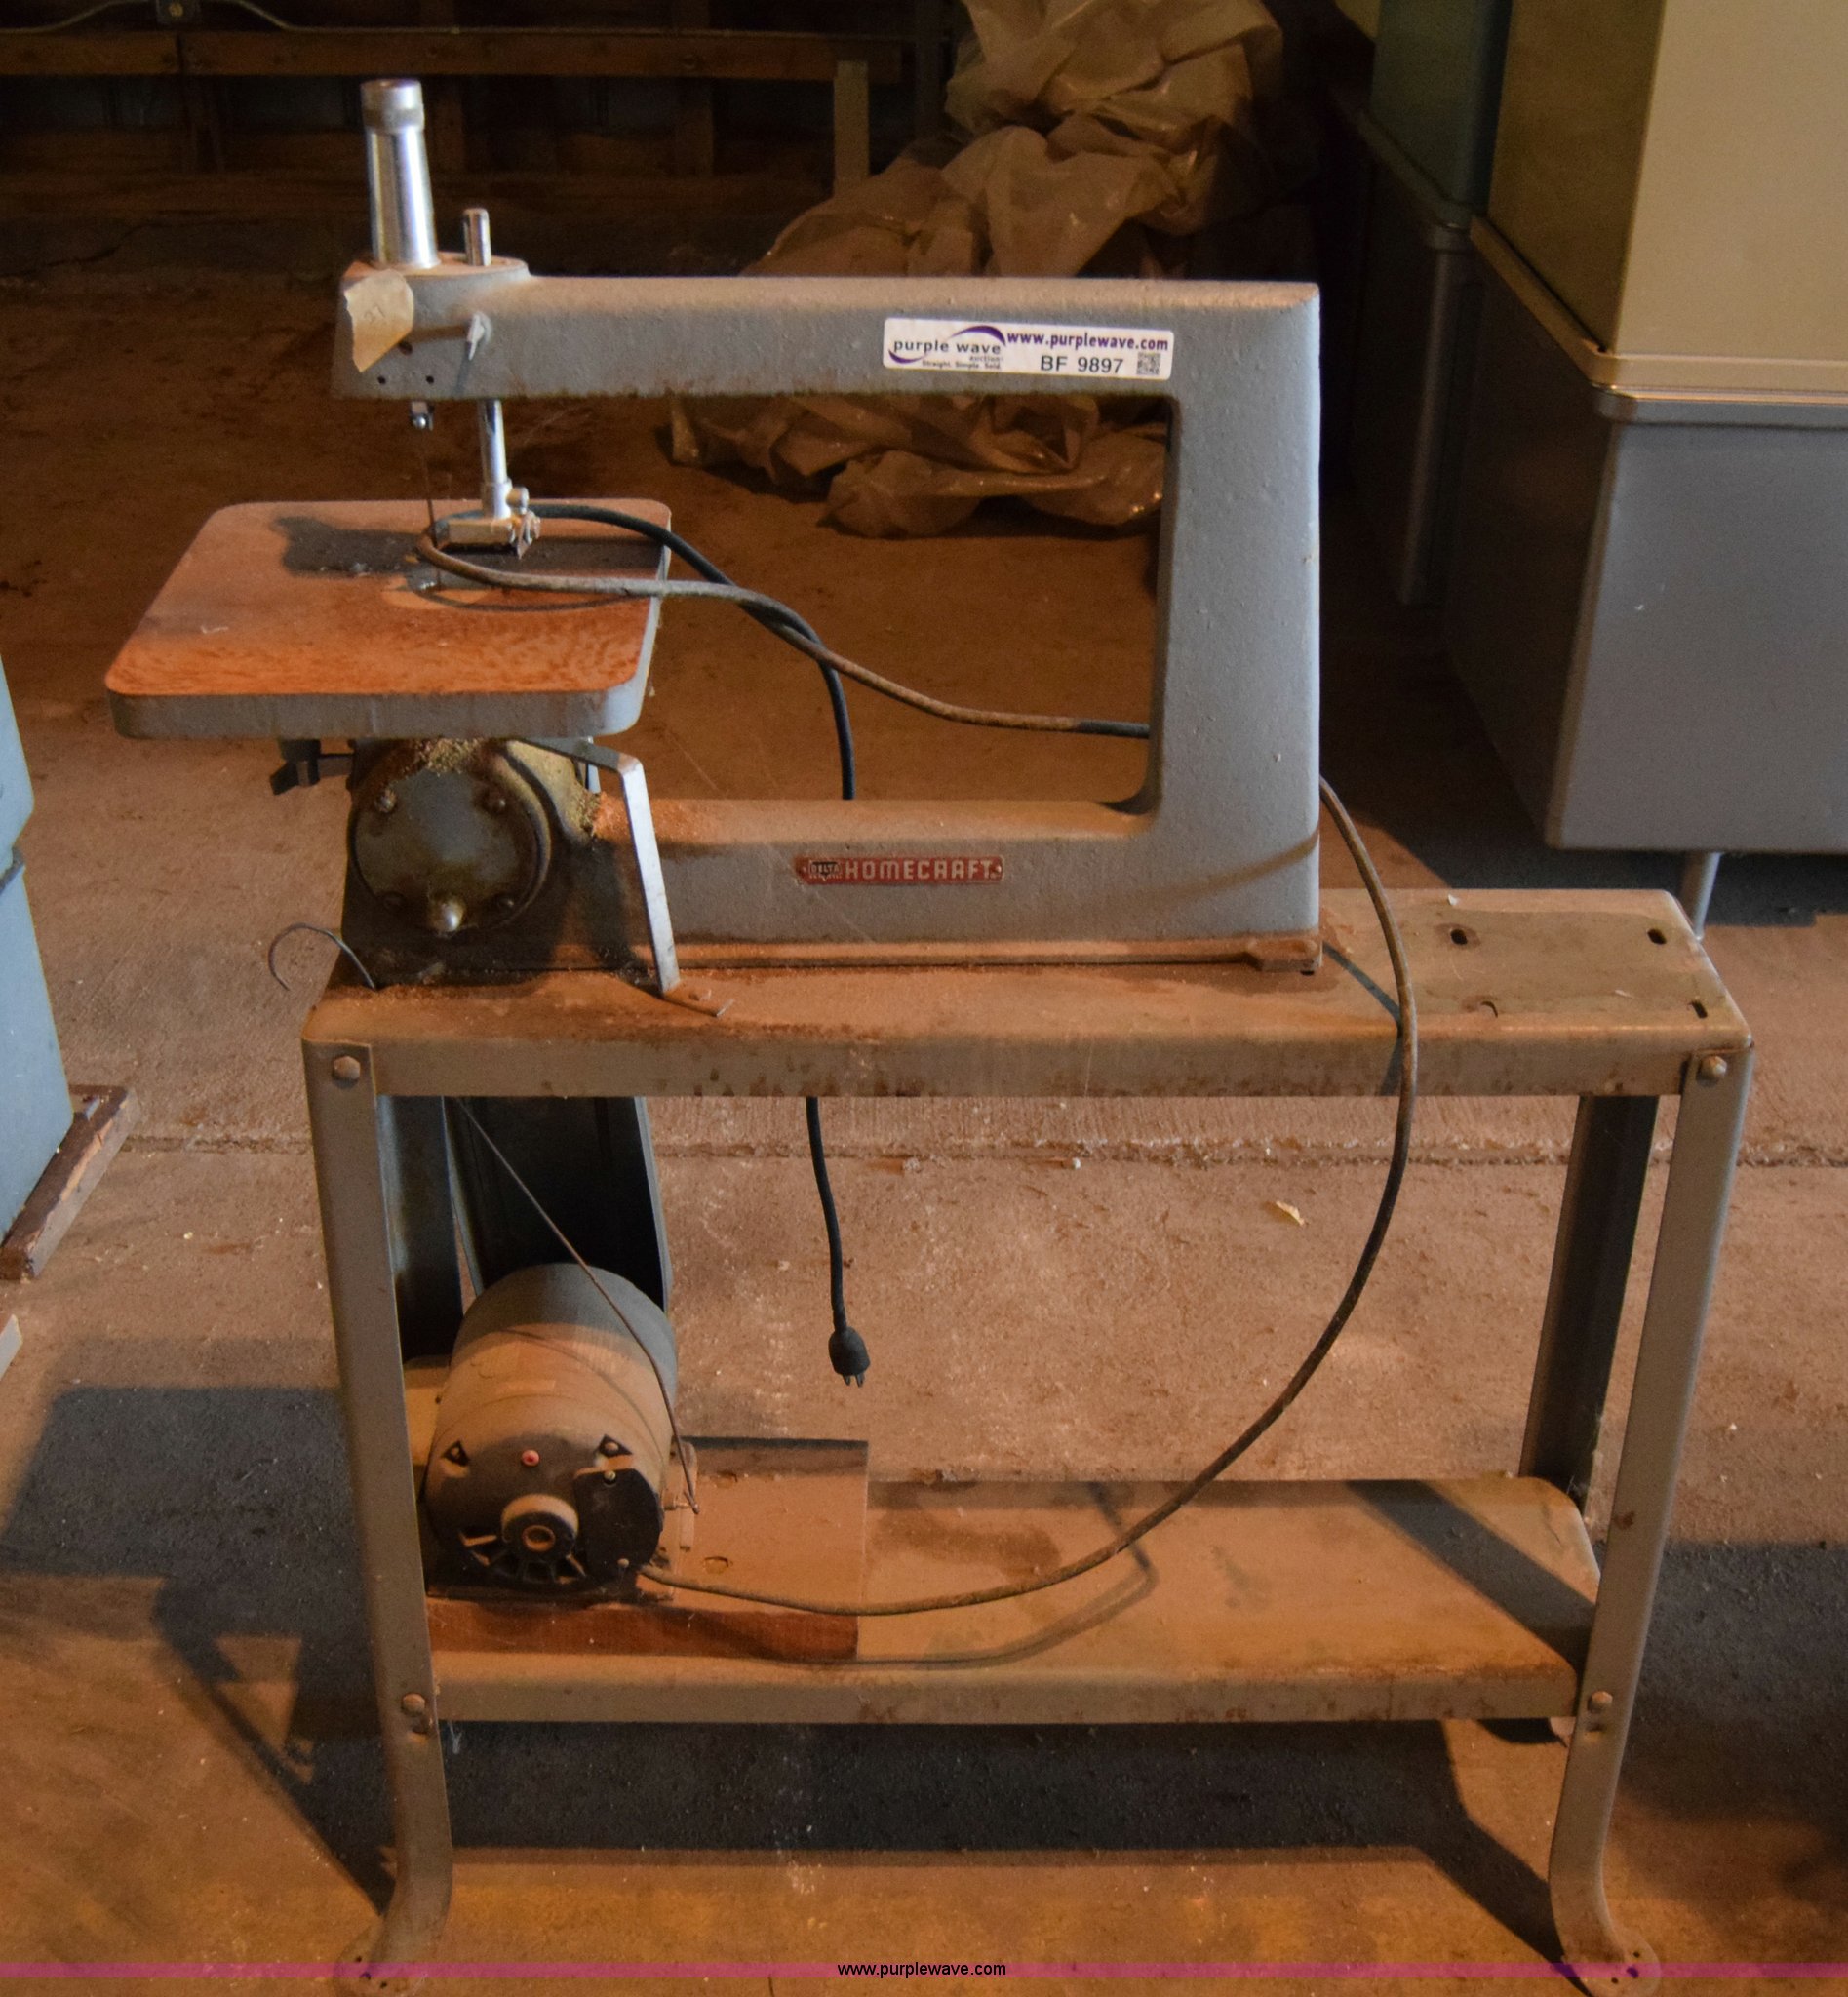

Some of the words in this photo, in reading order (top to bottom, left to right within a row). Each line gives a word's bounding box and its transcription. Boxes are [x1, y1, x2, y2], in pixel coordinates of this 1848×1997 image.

[893, 339, 949, 353] purple
[956, 343, 1002, 353] wave
[1006, 332, 1169, 351] www.purplewave.com
[1040, 355, 1068, 372] BF
[1078, 356, 1124, 374] 9897
[845, 860, 991, 880] HOMECRAFT
